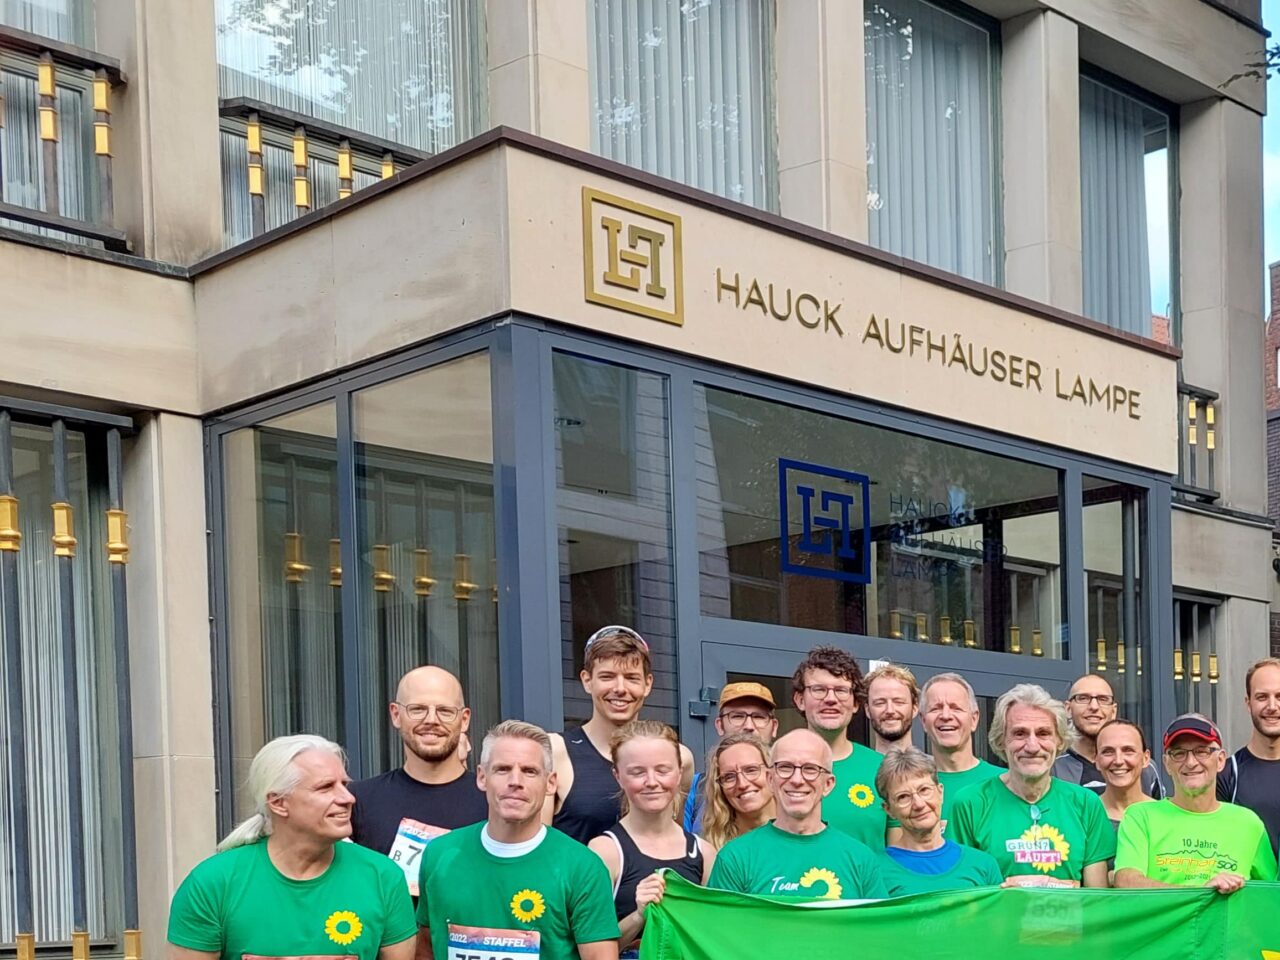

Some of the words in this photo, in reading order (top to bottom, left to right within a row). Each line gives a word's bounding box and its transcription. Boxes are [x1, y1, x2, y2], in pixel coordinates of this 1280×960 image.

[716, 267, 844, 337] HAUCK
[861, 312, 1042, 392] AUFHÄUSER
[1055, 367, 1142, 420] LAMPE
[1182, 838, 1192, 847] 10
[1194, 839, 1218, 849] Jahre
[393, 850, 402, 861] B
[771, 876, 799, 893] Team
[483, 936, 527, 948] STAFFEL
